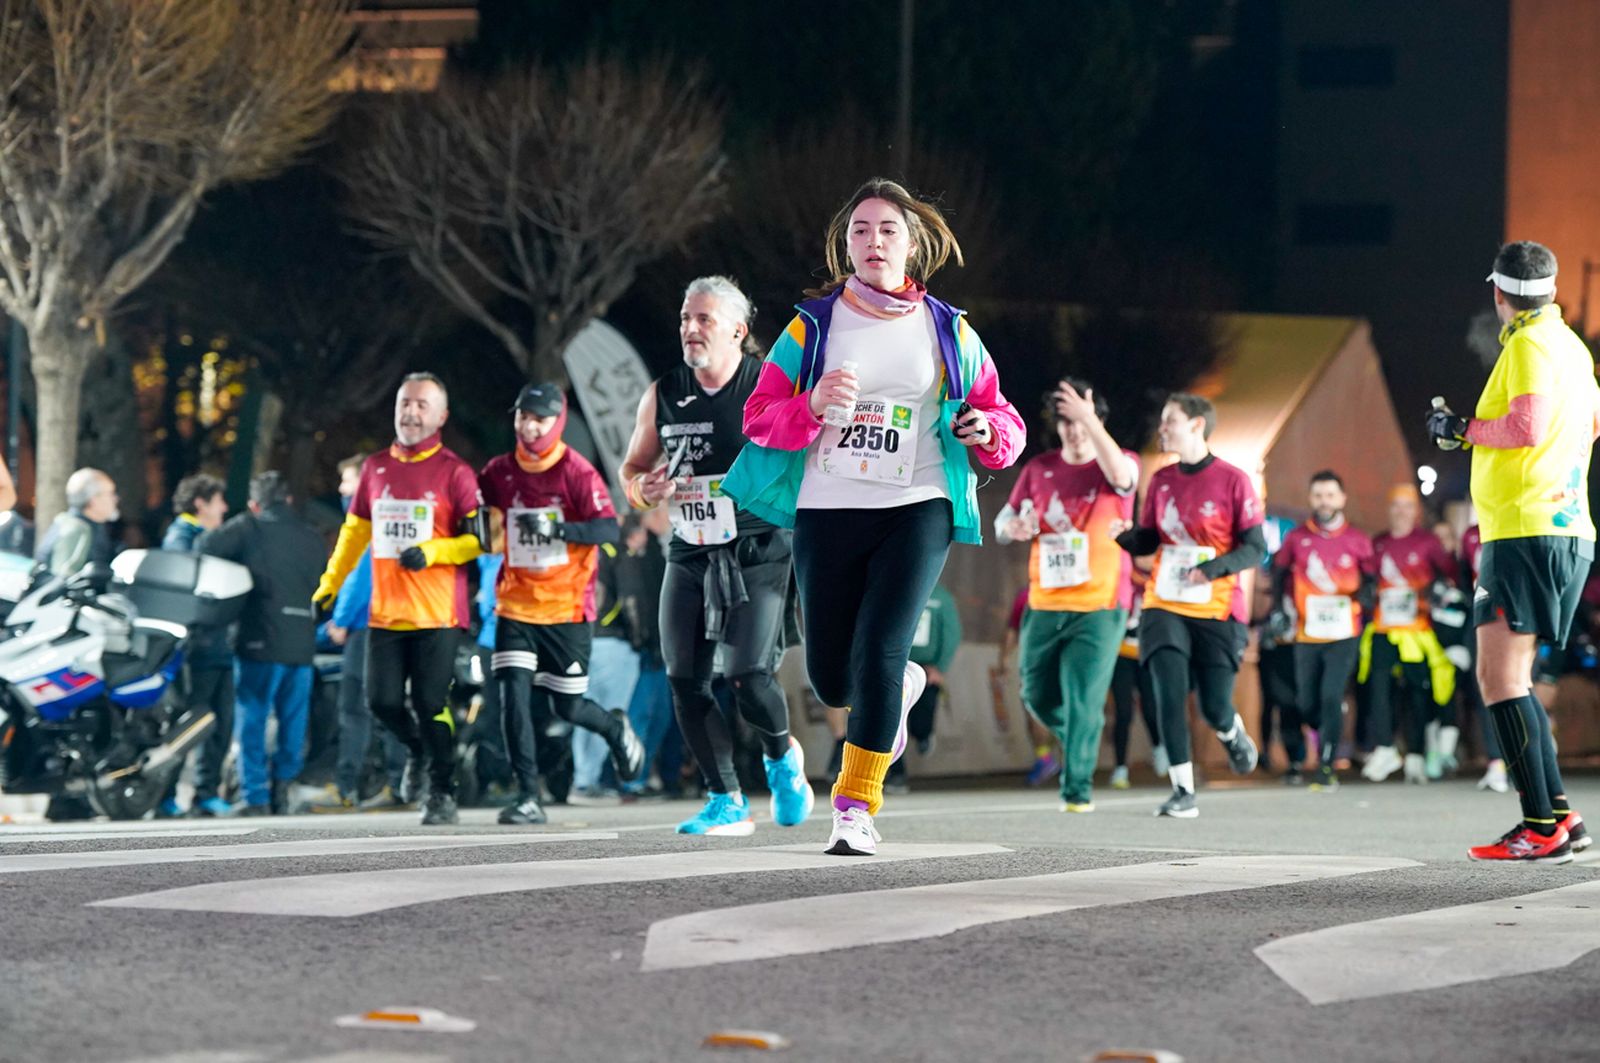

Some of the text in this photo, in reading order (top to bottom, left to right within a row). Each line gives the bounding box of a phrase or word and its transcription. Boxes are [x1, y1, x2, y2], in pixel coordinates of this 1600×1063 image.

[874, 404, 886, 413] DE
[837, 424, 900, 453] 2350
[680, 501, 716, 521] 1764
[384, 522, 417, 538] 4415
